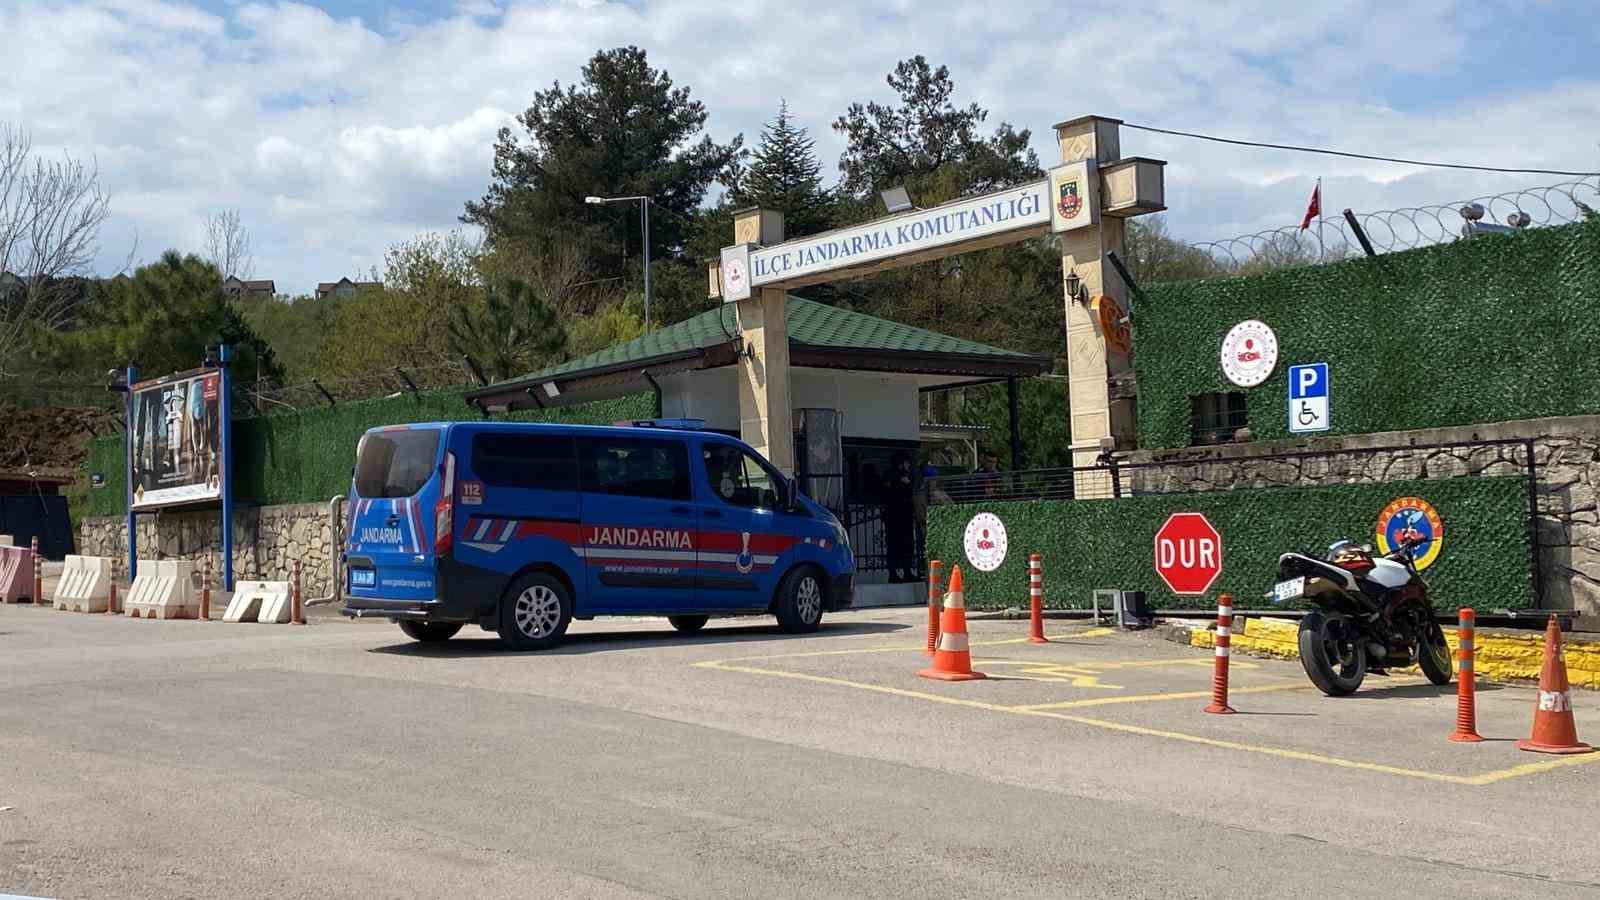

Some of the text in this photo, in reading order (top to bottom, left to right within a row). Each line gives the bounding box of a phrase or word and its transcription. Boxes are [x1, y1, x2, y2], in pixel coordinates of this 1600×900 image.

[755, 253, 792, 277] İLÇE
[796, 230, 893, 268] JANDARMA
[896, 192, 1041, 244] KOMUTANLIĞI
[1300, 368, 1318, 397] P
[464, 484, 481, 496] 112
[1379, 499, 1440, 529] JANDARMA
[360, 527, 403, 545] JANDARMA
[588, 527, 692, 549] JANDARMA
[1160, 538, 1216, 569] DUR
